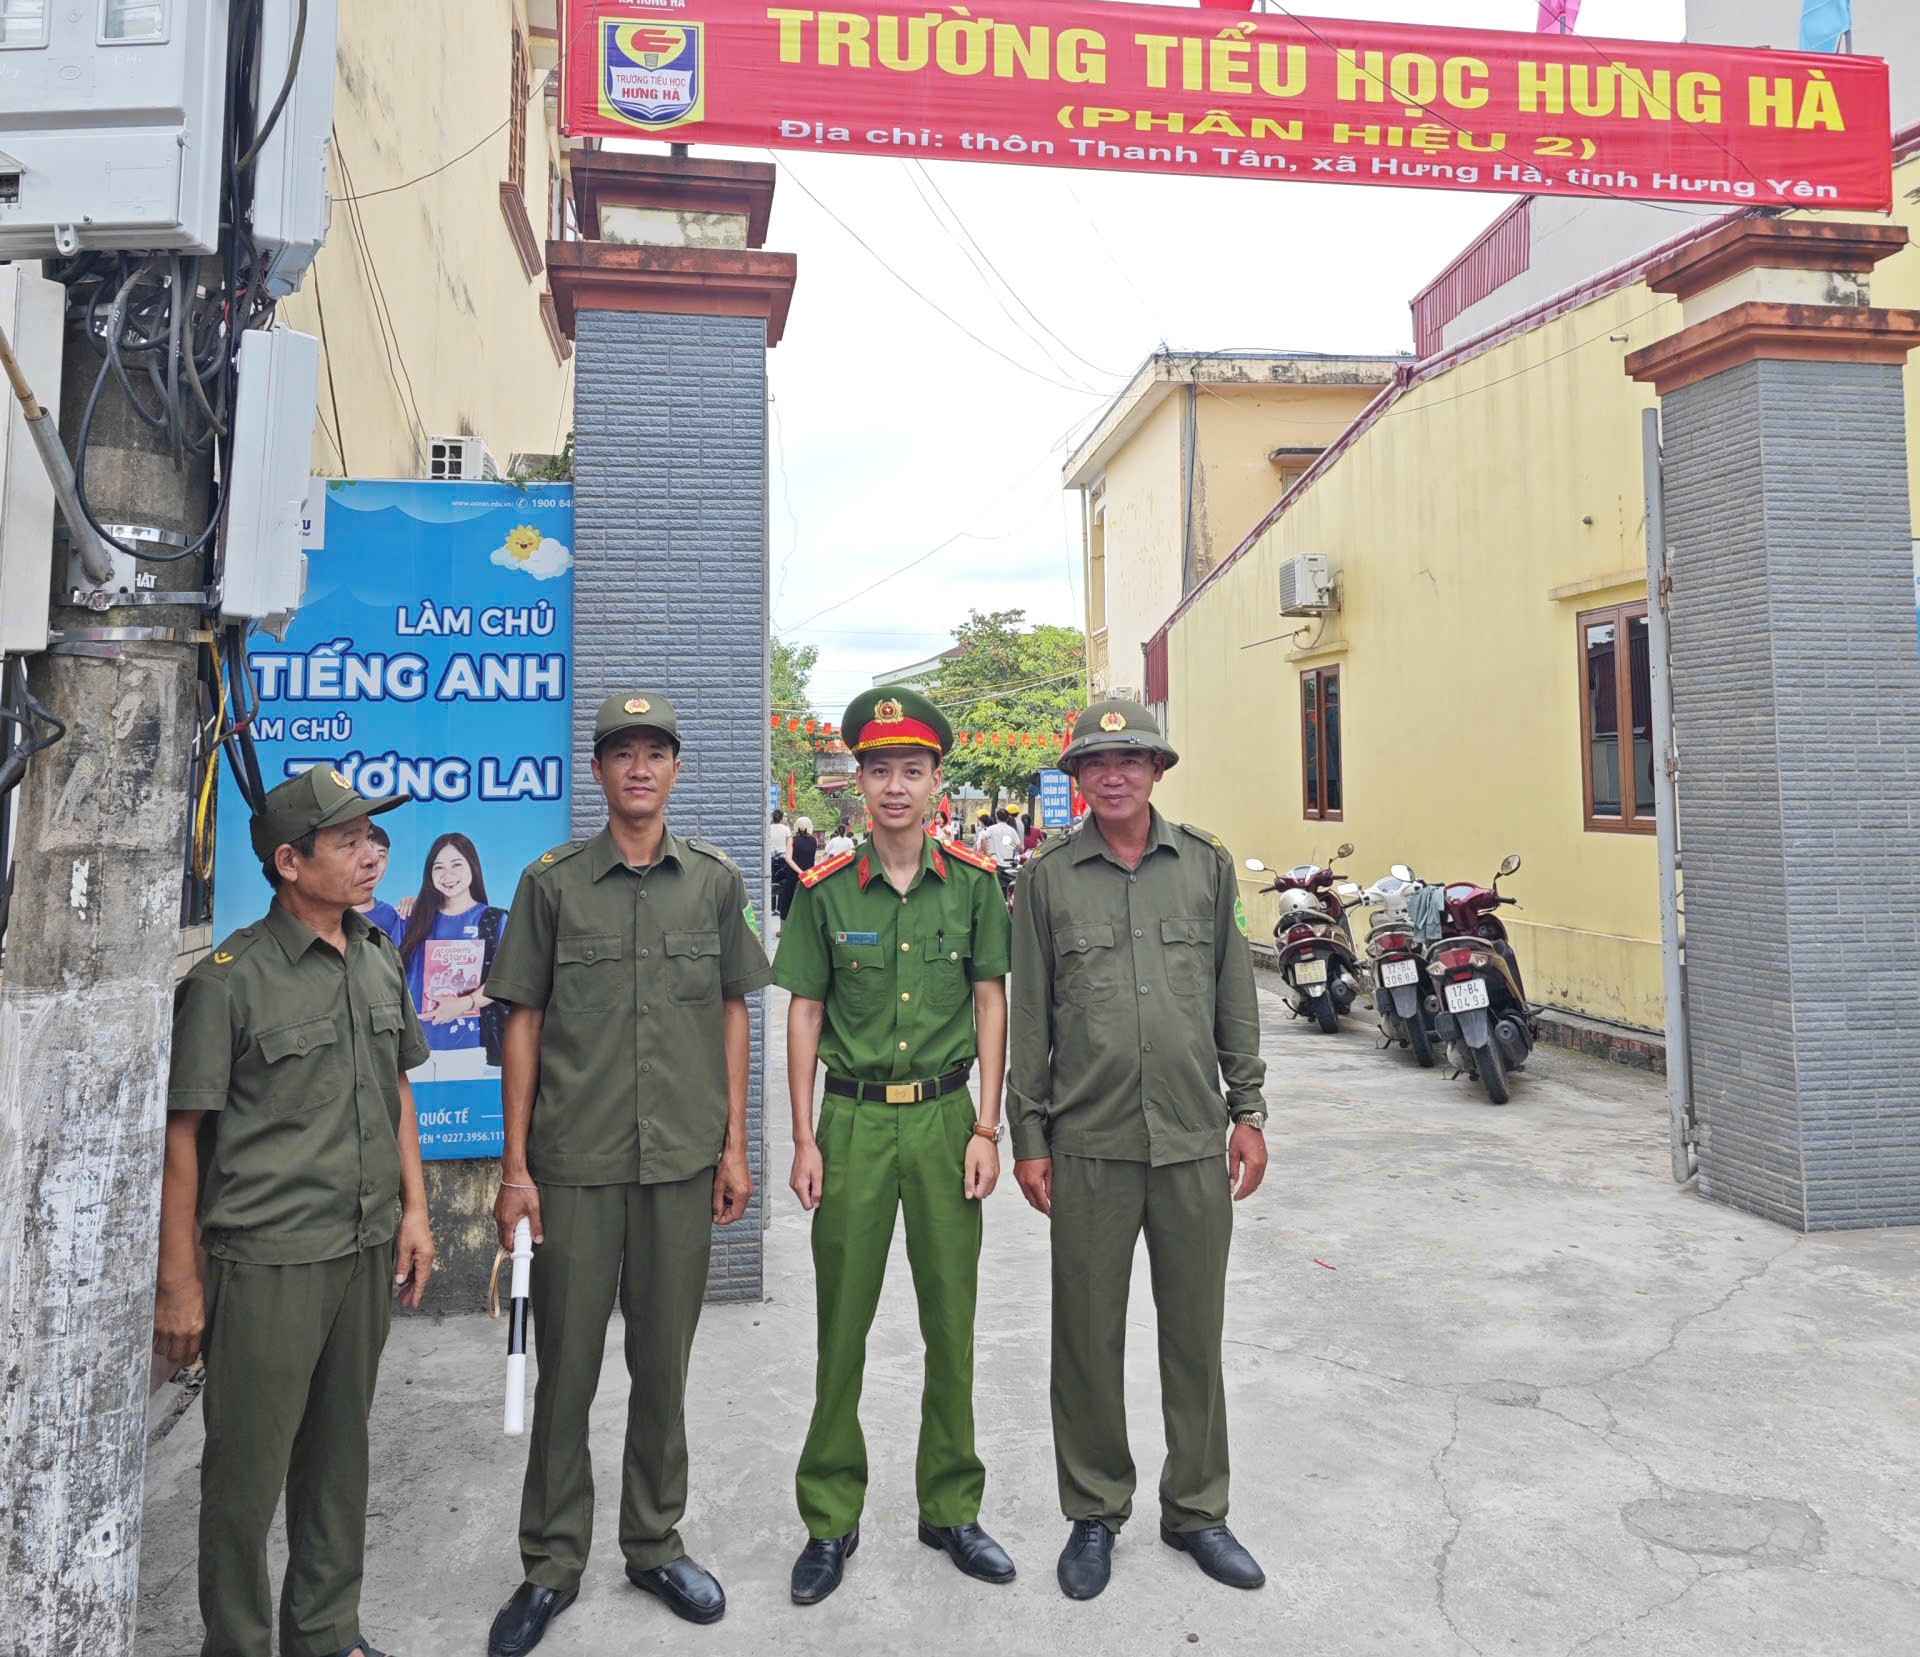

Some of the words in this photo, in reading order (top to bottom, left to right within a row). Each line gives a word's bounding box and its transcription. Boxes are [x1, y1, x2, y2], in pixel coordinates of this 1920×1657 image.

[616, 73, 648, 85] TRƯỜNG
[767, 6, 1106, 84] TRƯỜNG
[1135, 21, 1307, 97] TIỂU
[1337, 48, 1489, 117] HỌC
[1518, 61, 1721, 123] HƯNG
[1749, 69, 1845, 131] HÀ
[622, 87, 658, 99] HƯNG
[662, 86, 681, 101] HÀ
[1057, 105, 1303, 140] (PHÂN
[1333, 123, 1507, 154] HIỆU
[1533, 137, 1597, 160] 2)
[778, 119, 850, 144] Địa
[866, 127, 943, 148] chỉ:
[960, 132, 1054, 154] thôn
[1069, 138, 1198, 163] Thanh
[1212, 148, 1297, 172] Tân,
[1312, 156, 1357, 173] xã
[1371, 157, 1479, 183] Hưng
[1494, 165, 1552, 186] Hà,
[1566, 168, 1638, 188] tỉnh
[1652, 173, 1756, 197] Hưng
[1765, 179, 1838, 198] Yên
[532, 499, 556, 508] 1900
[397, 600, 471, 635] LÀM
[480, 601, 555, 635] CHỦ
[251, 640, 426, 699] TIẾNG
[438, 656, 562, 699] ANH
[291, 713, 352, 741] CHỦ
[481, 760, 558, 796] LAI
[1385, 972, 1417, 986] 306.85
[1387, 962, 1411, 975] 17-B4
[1452, 983, 1479, 997] 17-B4
[1451, 994, 1486, 1011] 404.93
[419, 1107, 452, 1127] QUỐC
[454, 1106, 470, 1124] TẾ
